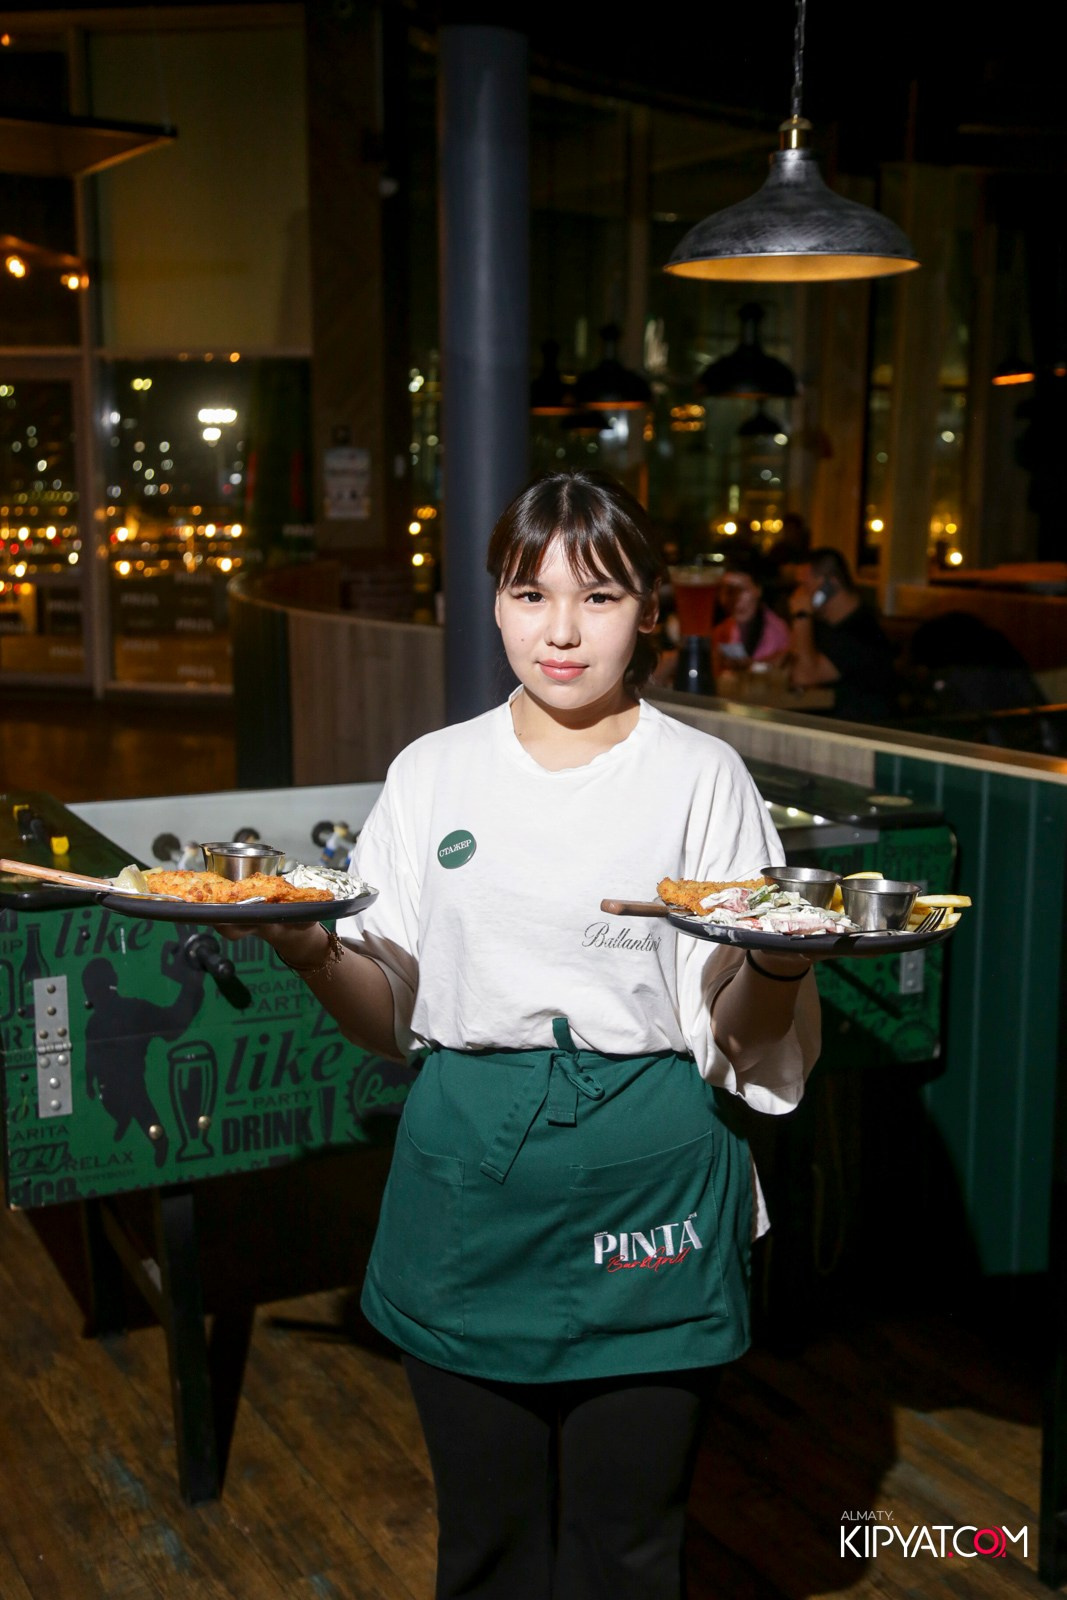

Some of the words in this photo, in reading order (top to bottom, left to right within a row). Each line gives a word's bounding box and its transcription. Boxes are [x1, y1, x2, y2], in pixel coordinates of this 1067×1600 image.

[439, 839, 472, 857] СТАЖЕР
[54, 908, 155, 957] like
[225, 1030, 344, 1094] like
[252, 1090, 312, 1108] PARTY
[63, 1150, 134, 1171] RELAX
